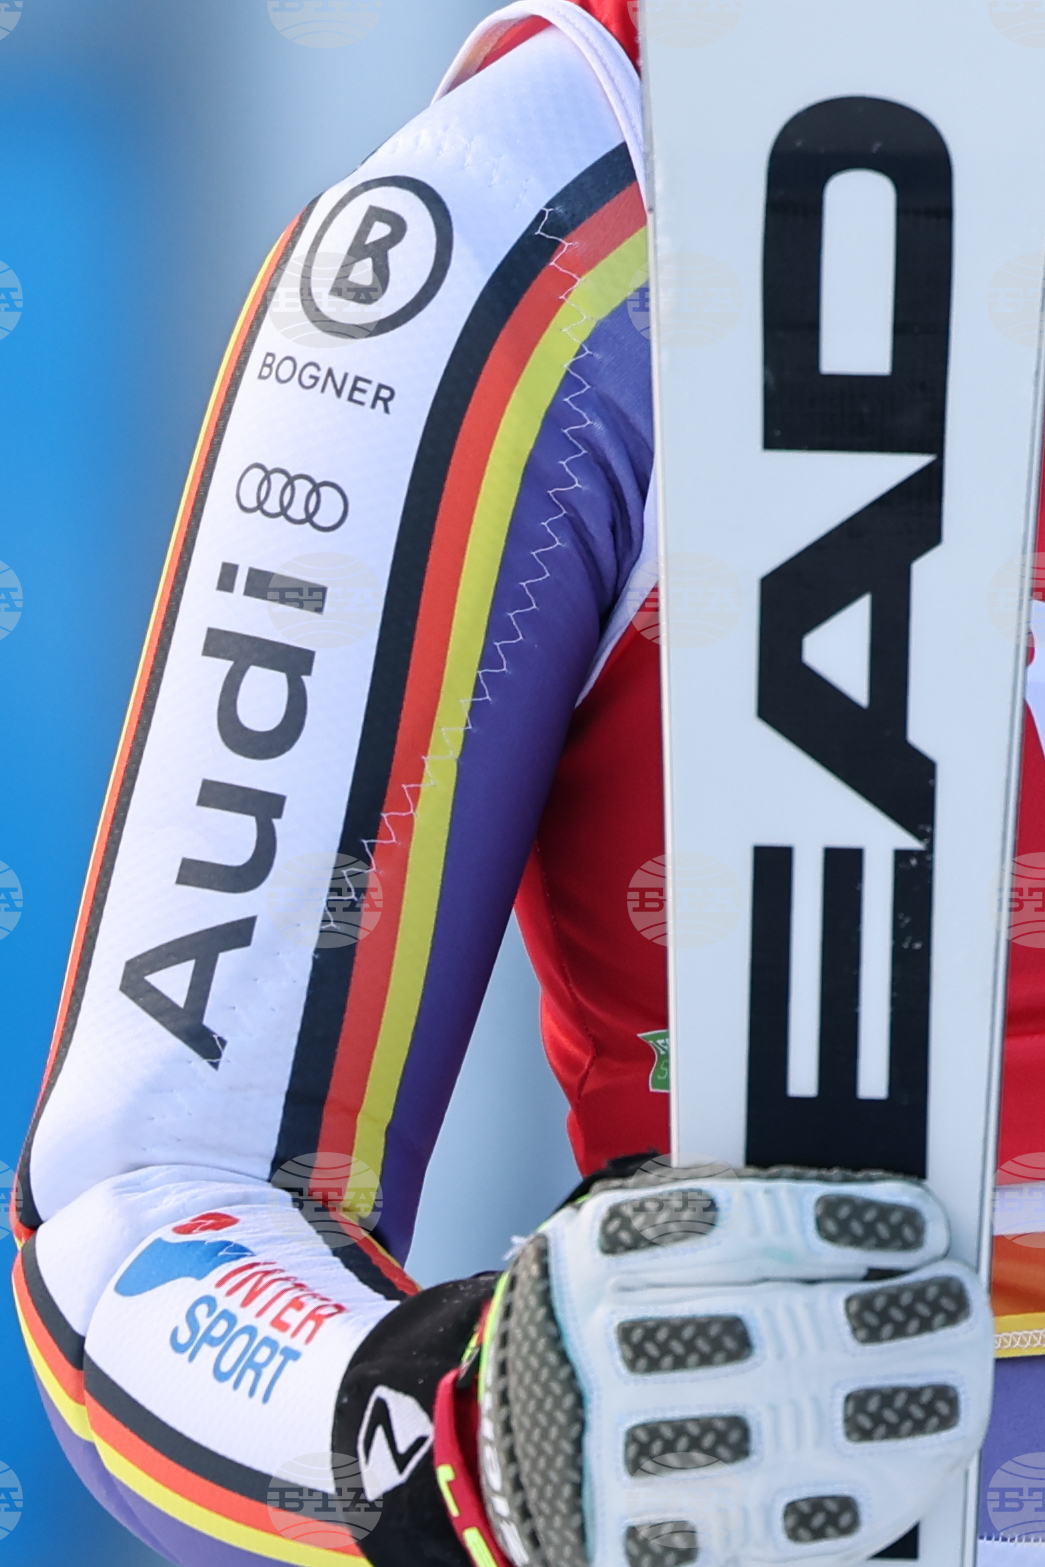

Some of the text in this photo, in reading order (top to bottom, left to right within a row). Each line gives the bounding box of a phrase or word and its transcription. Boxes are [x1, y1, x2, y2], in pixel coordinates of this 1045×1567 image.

[257, 352, 396, 415] BOGNER
[745, 95, 953, 1179] EAD
[119, 561, 328, 1071] Audi
[169, 1294, 302, 1405] SPORT
[214, 1261, 348, 1346] INTER
